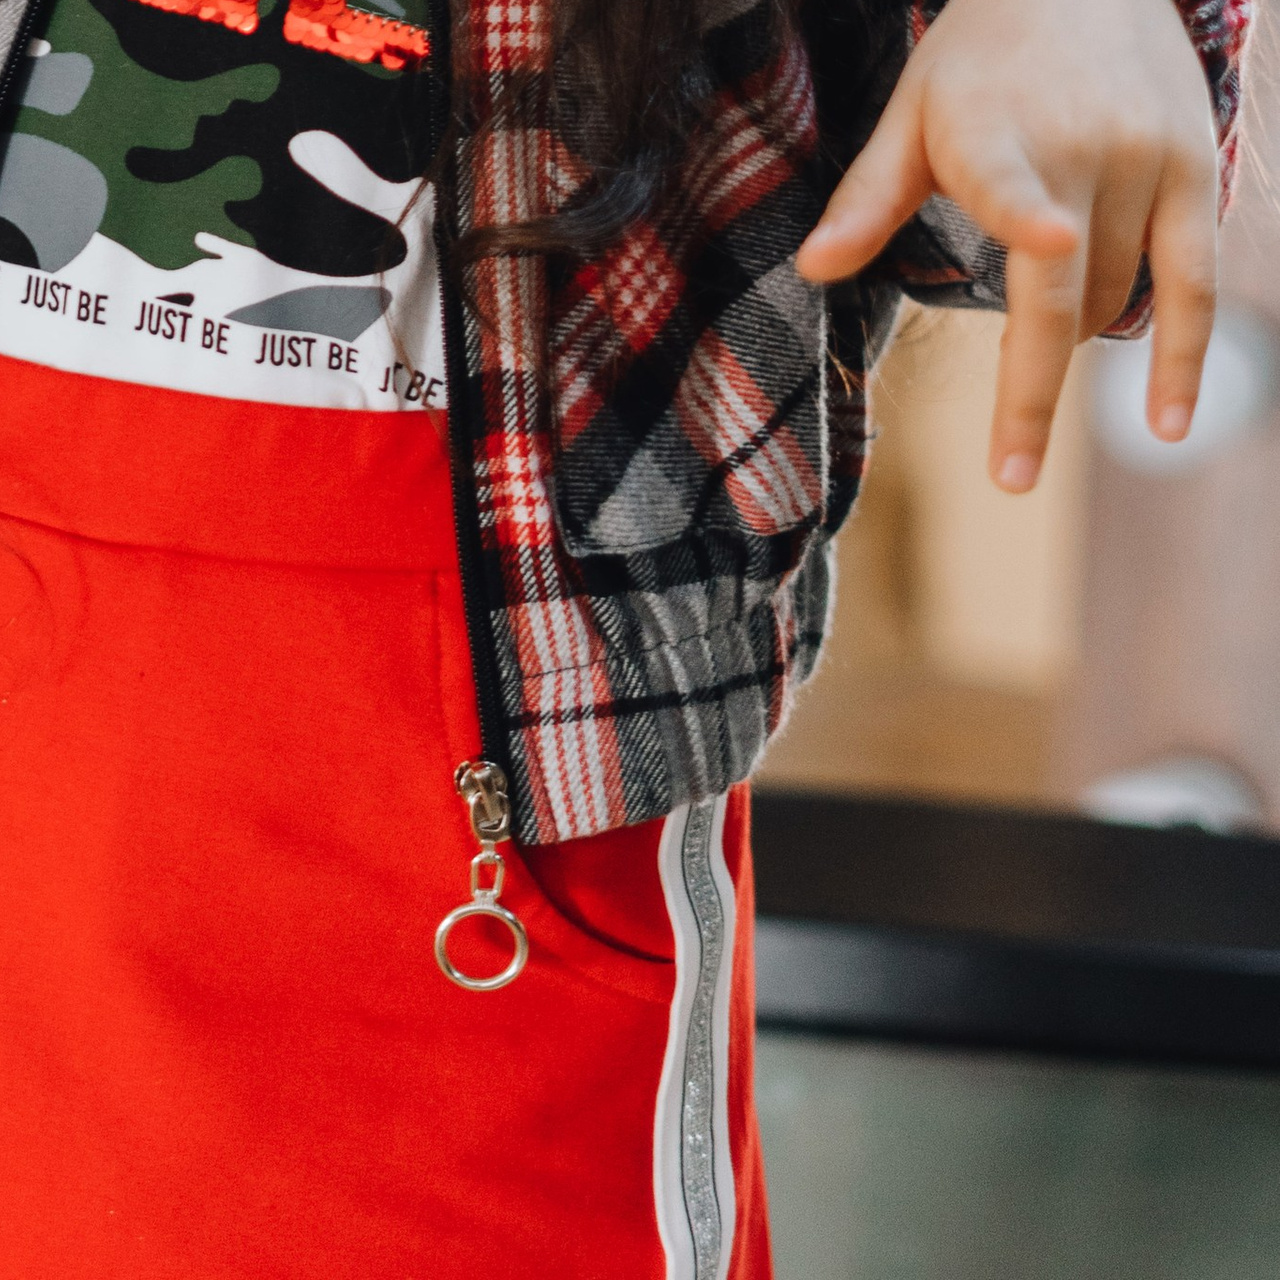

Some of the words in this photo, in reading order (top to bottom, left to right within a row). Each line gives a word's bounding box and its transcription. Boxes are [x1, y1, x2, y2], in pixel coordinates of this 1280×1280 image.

[21, 274, 72, 316] JUST
[77, 290, 109, 325] BE
[134, 300, 193, 344] JUST
[201, 319, 232, 356] BE
[254, 333, 318, 368] JUST
[328, 341, 360, 375] BE
[405, 370, 443, 408] BE
